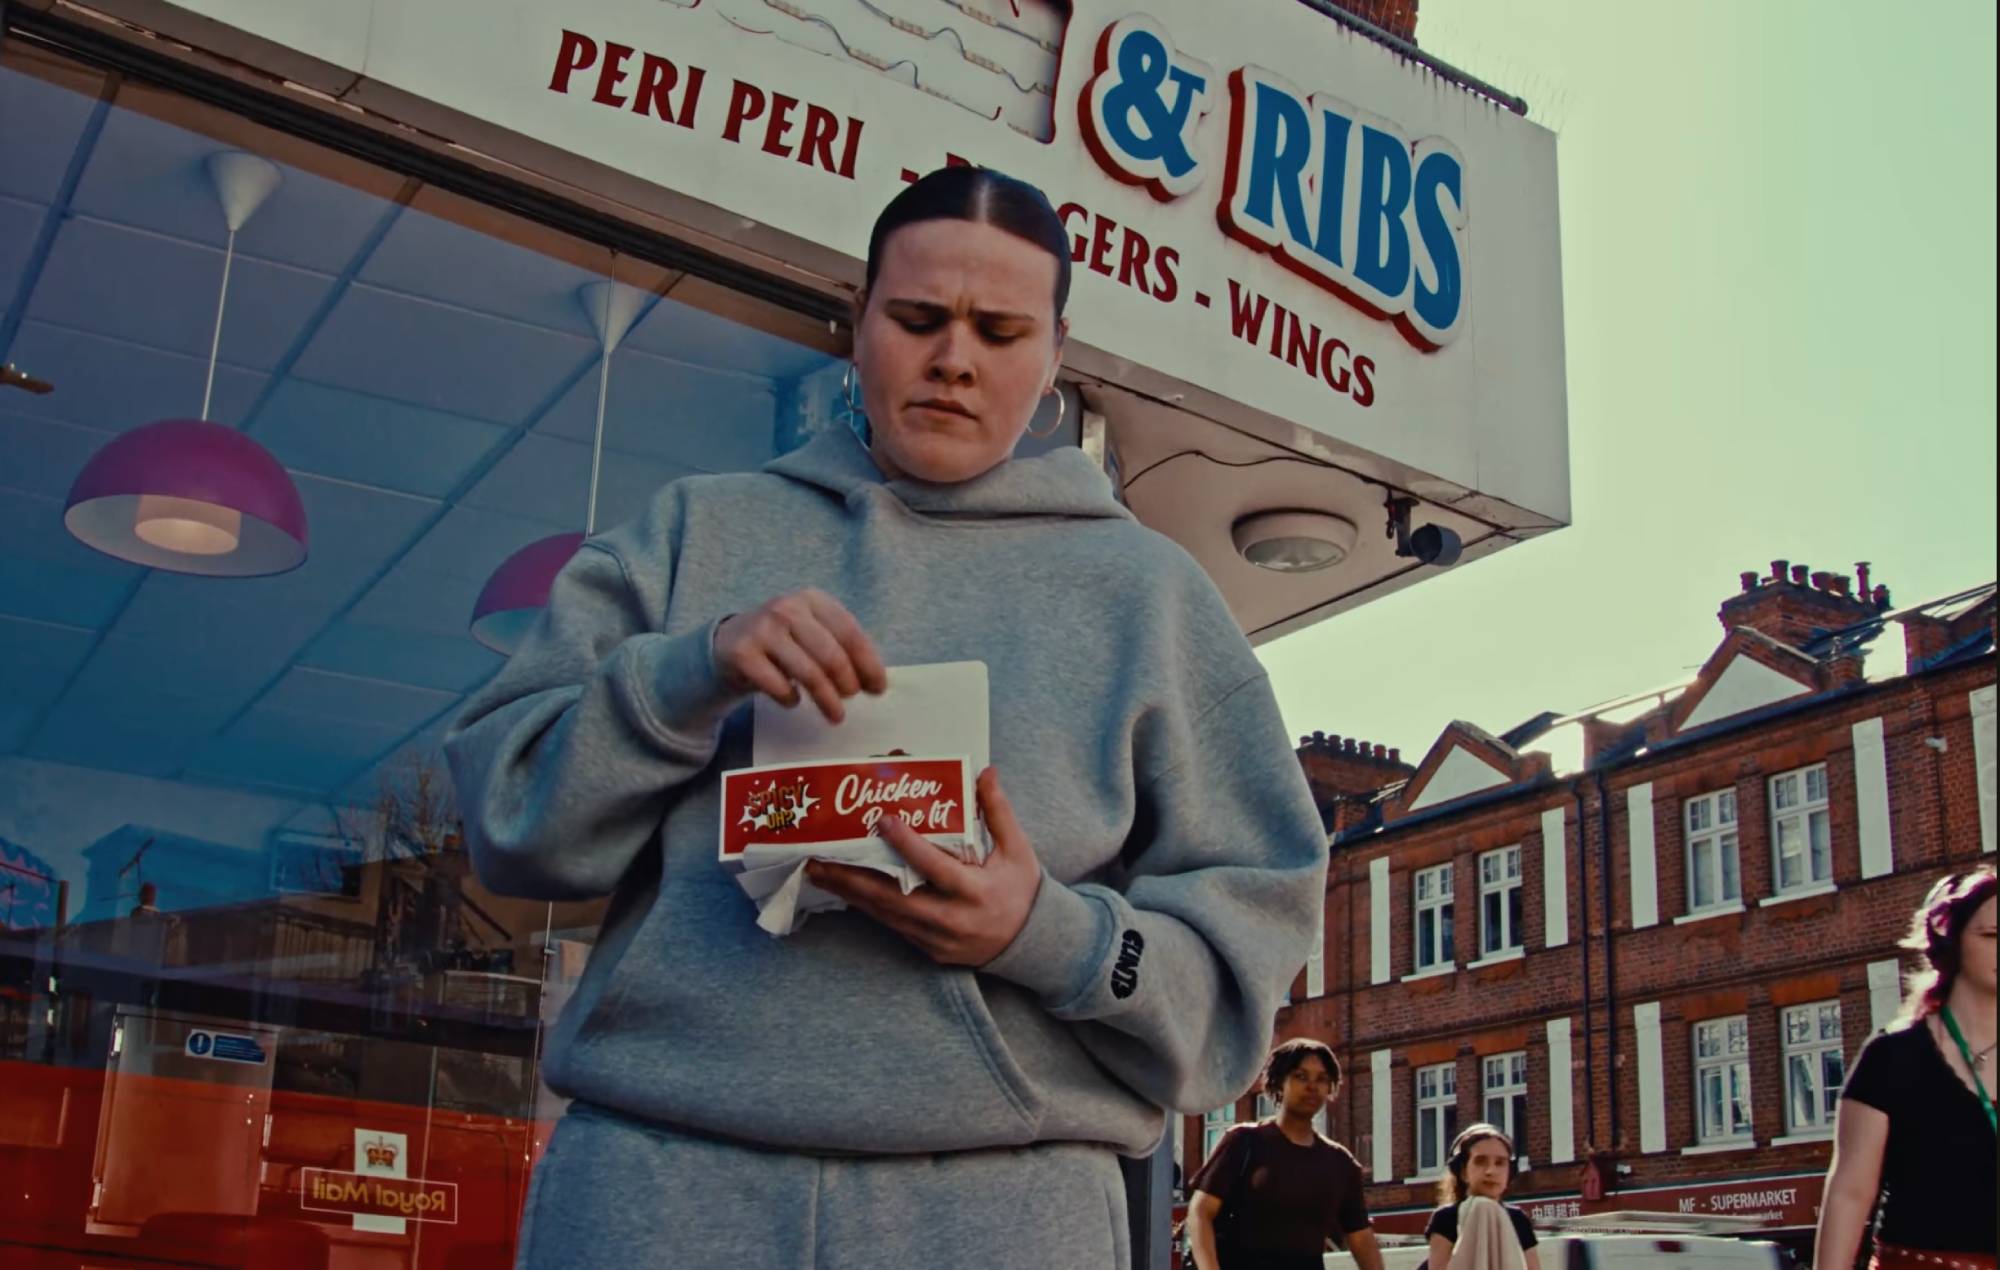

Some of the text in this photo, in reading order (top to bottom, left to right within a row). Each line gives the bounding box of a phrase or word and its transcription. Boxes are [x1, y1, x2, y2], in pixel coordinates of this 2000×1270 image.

[548, 29, 706, 129] PERI
[721, 78, 864, 180] PERI
[1227, 278, 1376, 407] WINGS
[1102, 30, 1462, 330] & RIBS
[835, 772, 943, 815] Chicken
[1679, 1197, 1696, 1212] MF
[1710, 1189, 1797, 1211] SUPERMARKET
